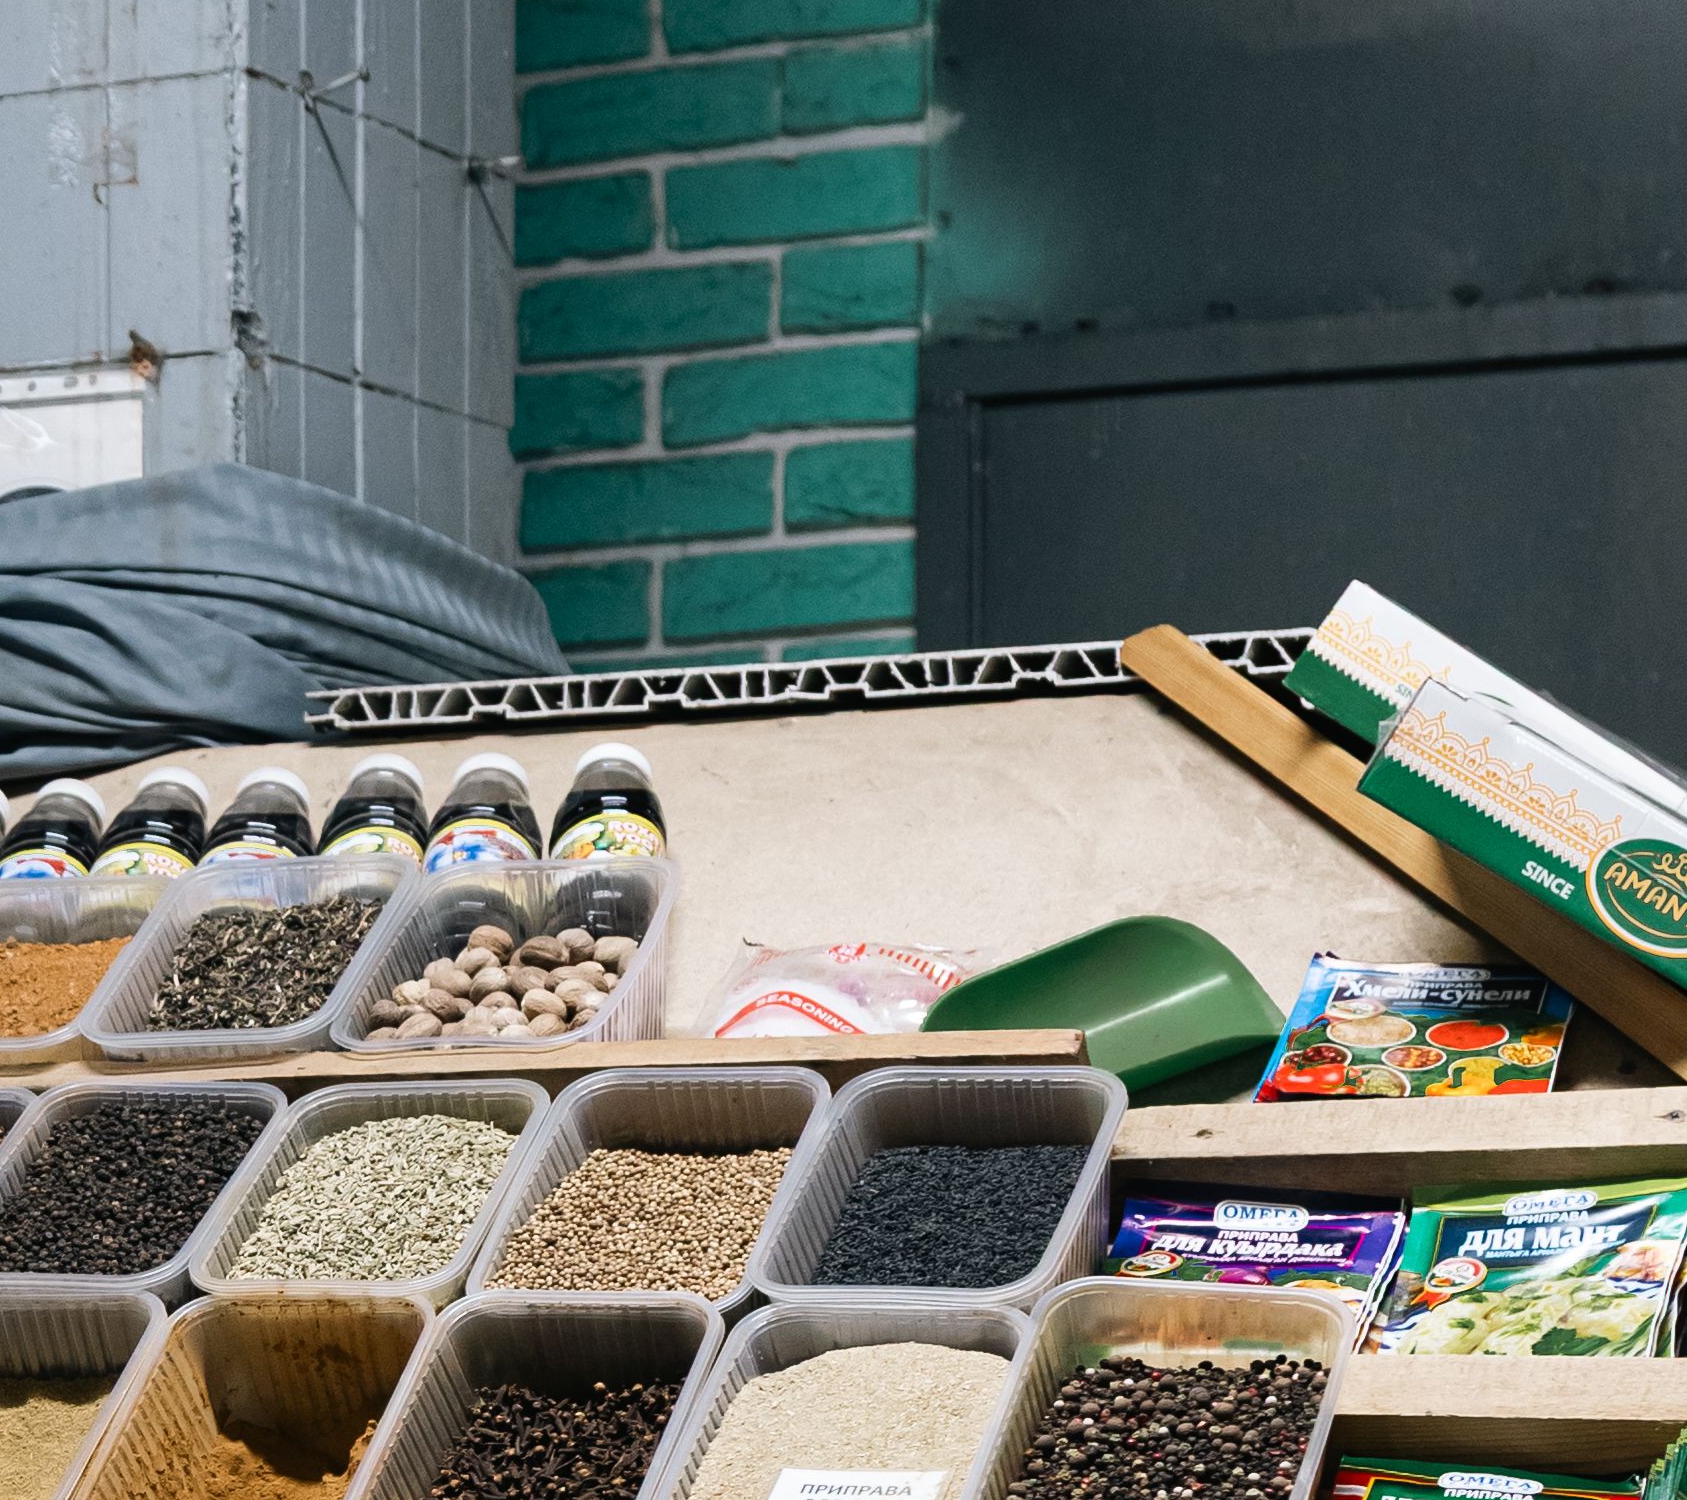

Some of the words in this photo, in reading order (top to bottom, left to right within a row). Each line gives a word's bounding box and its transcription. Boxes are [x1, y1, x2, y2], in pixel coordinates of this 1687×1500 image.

[1522, 860, 1575, 900] SINCE
[1344, 979, 1531, 1005] Хмели-сунели
[1404, 980, 1483, 989] ПРИПРАВА
[755, 993, 855, 1034] SEASONING
[1512, 1195, 1589, 1212] ОМЕГА
[1223, 1204, 1298, 1220] ОМЕГА
[1506, 1211, 1590, 1226] ПРИПРАВА
[1151, 1235, 1207, 1253] для
[1217, 1229, 1299, 1243] ПРИПРАВА
[1458, 1229, 1525, 1258] для
[1449, 1474, 1533, 1489] ОМЕГА
[799, 1483, 912, 1497] ПРИПРАВА
